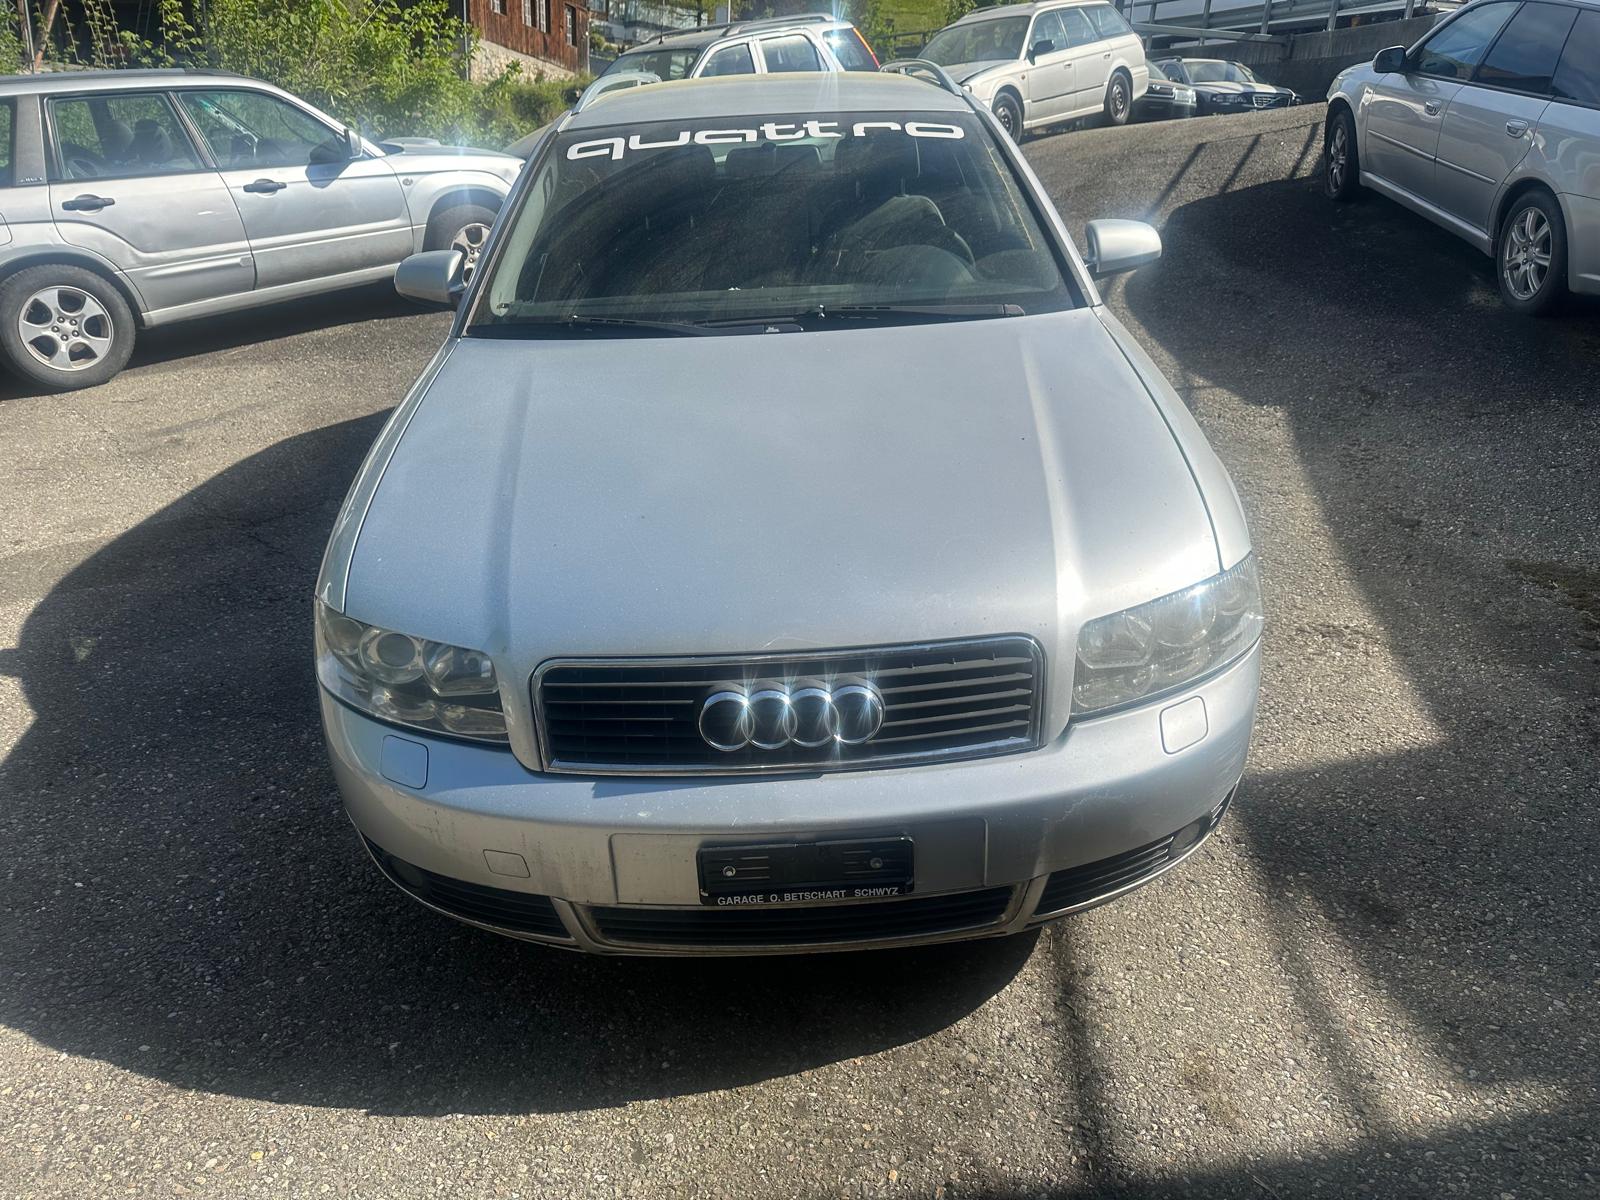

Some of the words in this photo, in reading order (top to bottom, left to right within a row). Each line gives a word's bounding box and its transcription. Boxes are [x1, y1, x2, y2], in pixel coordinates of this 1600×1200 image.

[566, 120, 966, 161] quattro
[717, 894, 765, 906] GARAGE
[769, 893, 781, 903] O.
[783, 889, 847, 902] BETSCHART
[854, 887, 899, 897] SCHWYZ
